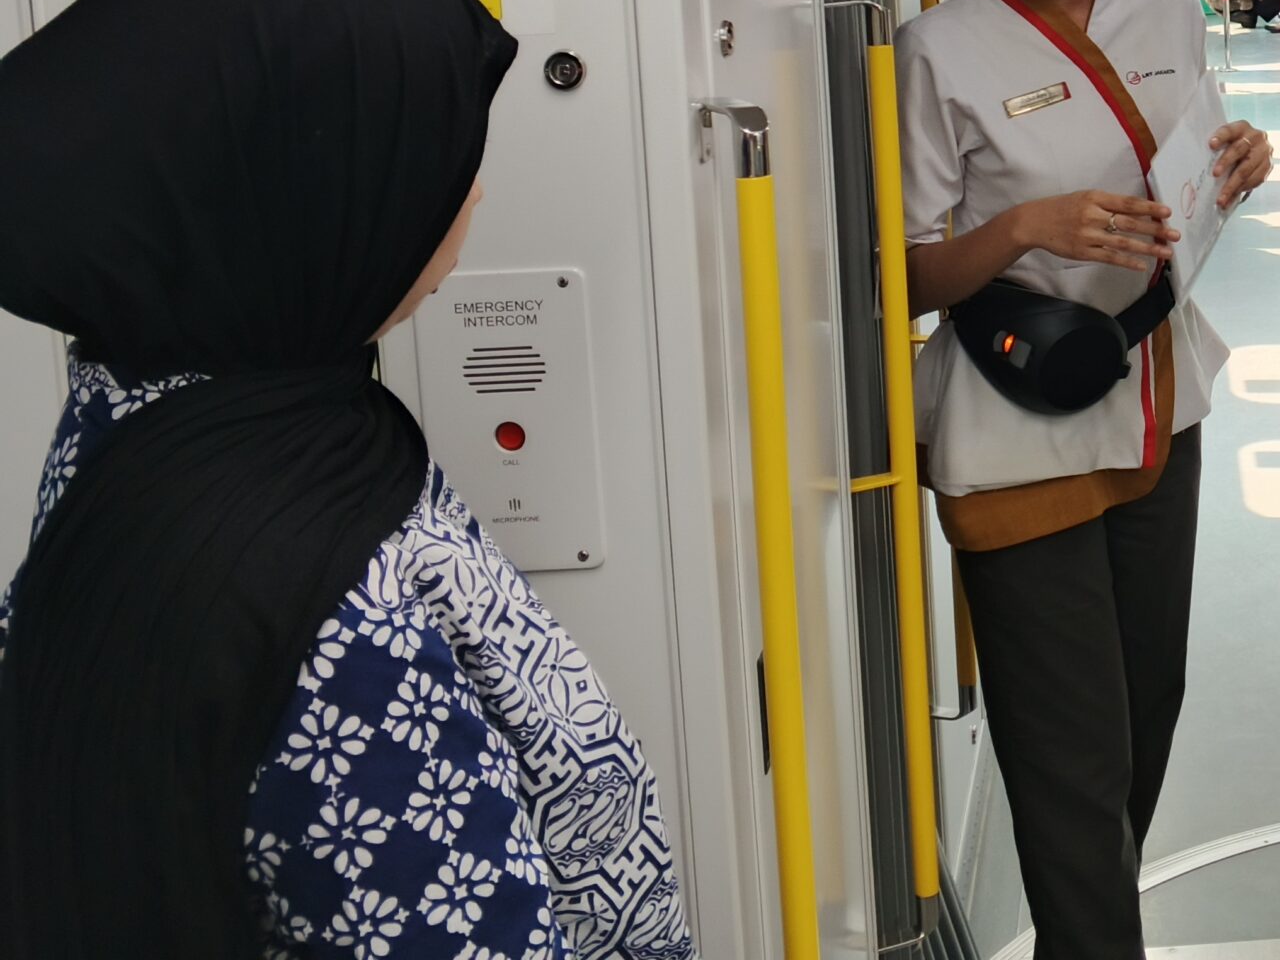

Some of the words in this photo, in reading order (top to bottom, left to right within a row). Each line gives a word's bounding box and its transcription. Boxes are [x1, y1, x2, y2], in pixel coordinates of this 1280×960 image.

[454, 299, 543, 314] EMERGENCY
[463, 314, 538, 328] INTERCOM
[491, 516, 540, 524] MICROPHONE
